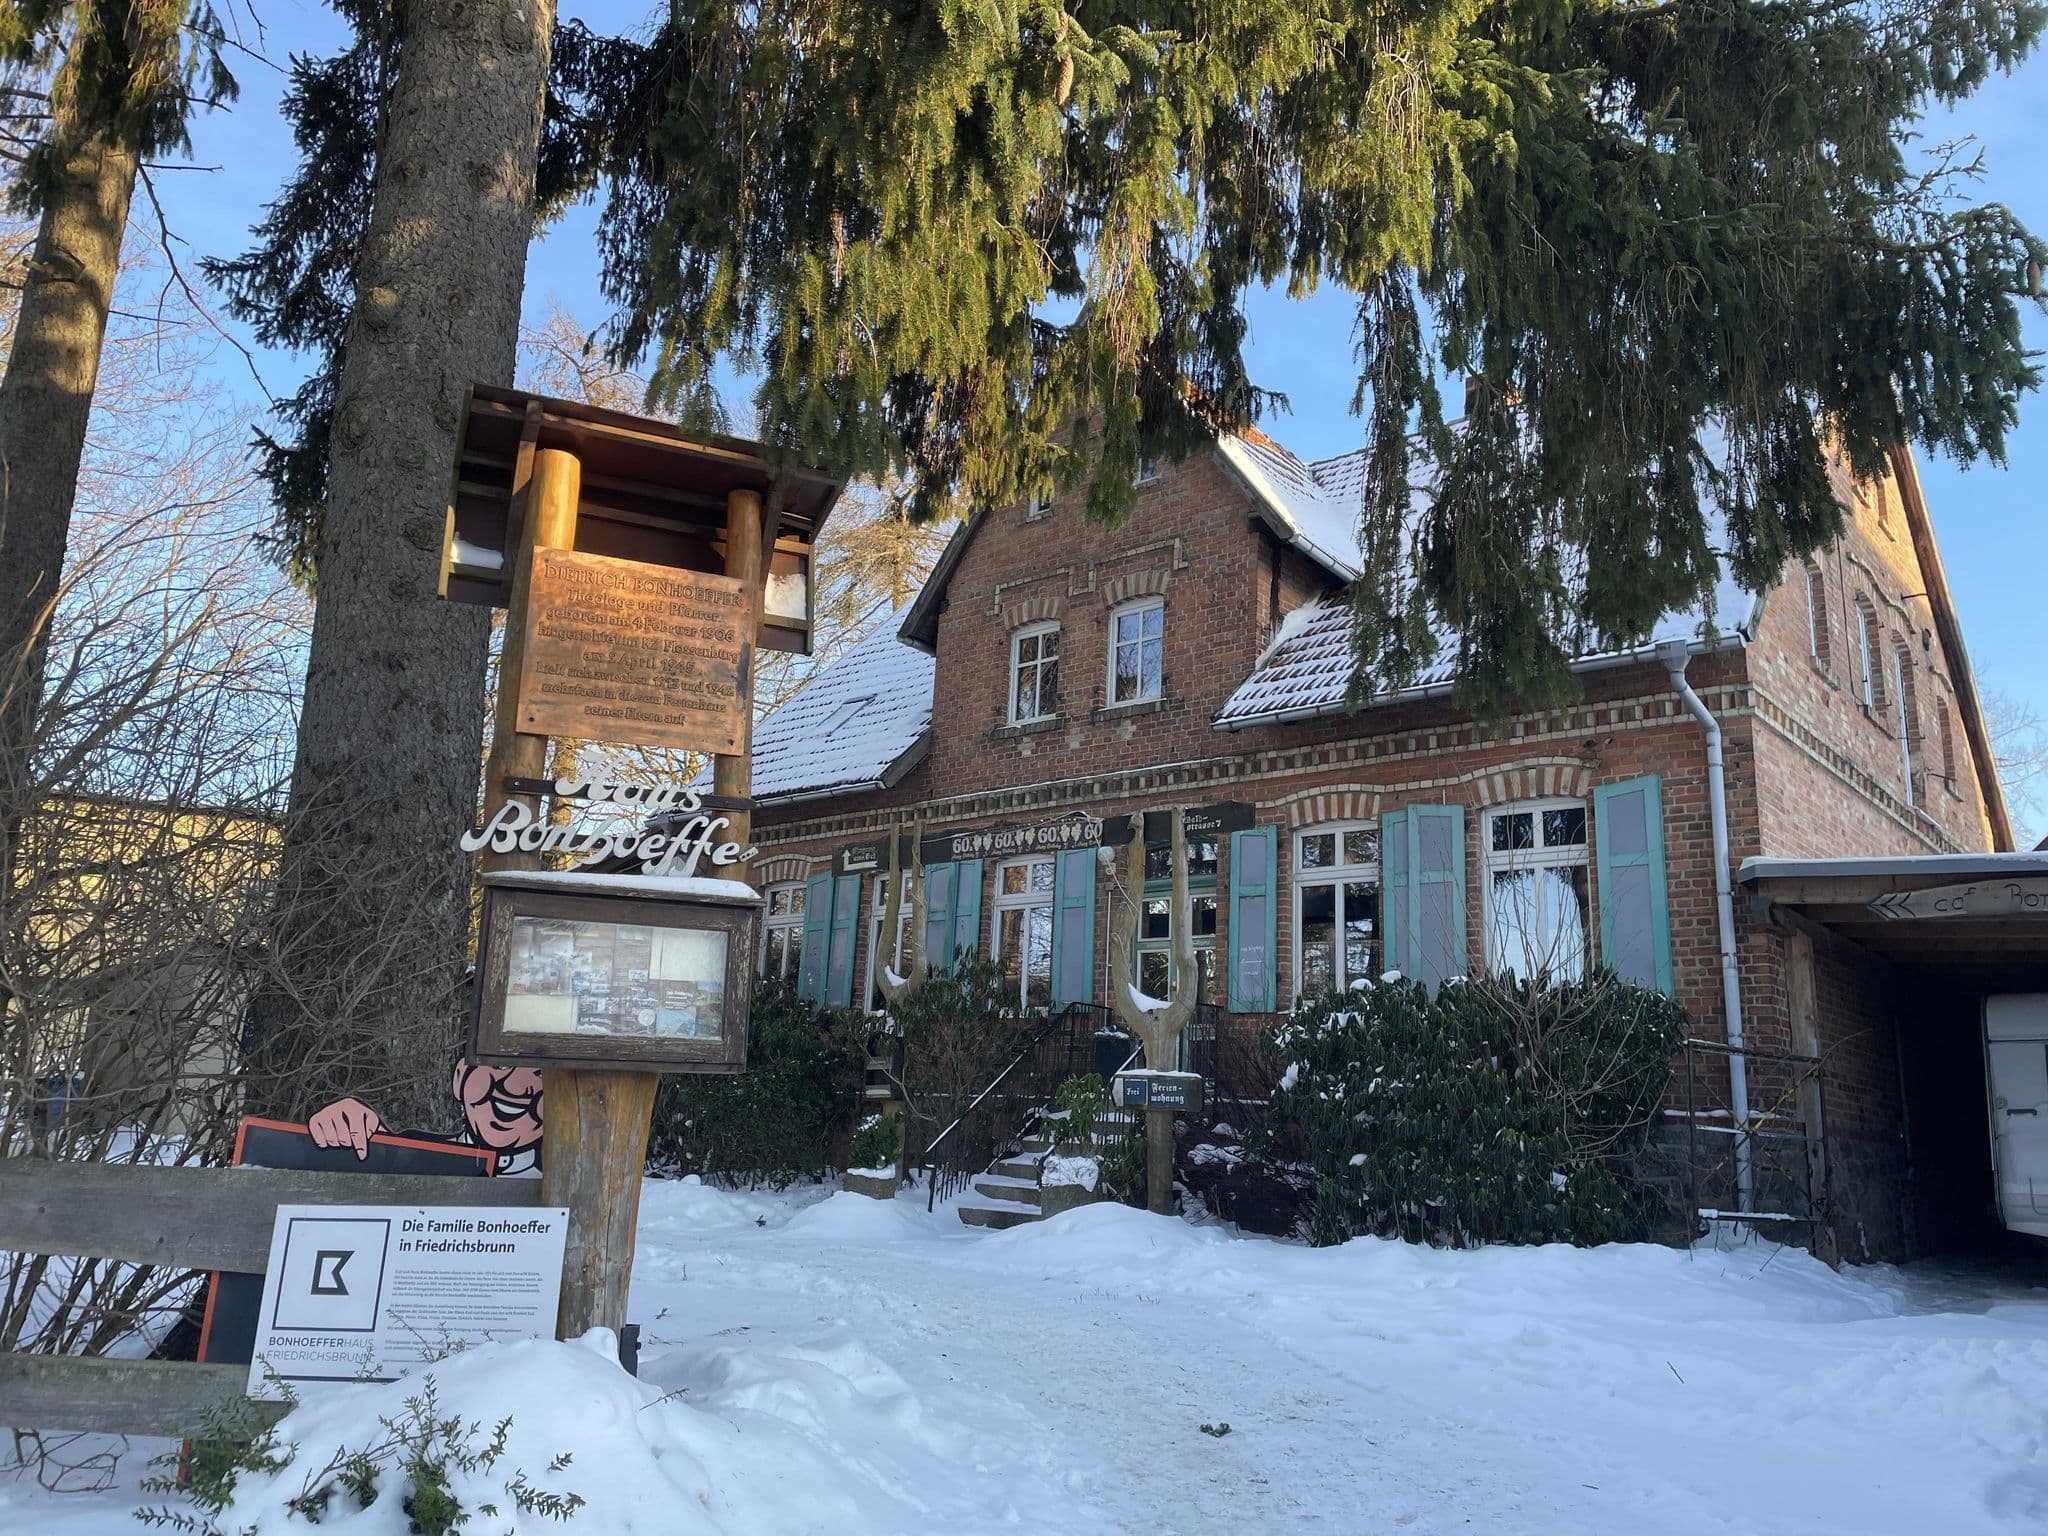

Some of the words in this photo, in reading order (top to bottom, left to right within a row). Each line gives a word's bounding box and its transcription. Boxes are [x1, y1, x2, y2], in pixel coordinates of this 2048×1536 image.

[545, 564, 627, 590] DIETRICH
[633, 577, 743, 607] BONHOEFFER
[568, 587, 635, 609] Theologe
[638, 601, 665, 613] und
[546, 606, 606, 624] geboren
[609, 615, 629, 627] am
[644, 617, 697, 637] Februar
[700, 627, 735, 642] 1906
[641, 637, 658, 651] KZ
[617, 653, 656, 670] April
[661, 657, 695, 674] 1945
[681, 681, 704, 693] und
[555, 750, 706, 812] Haus
[1151, 1094, 1185, 1104] wohnung
[402, 1219, 424, 1232] Die
[427, 1219, 474, 1233] Familie
[477, 1220, 551, 1234] Bonhoeffer
[399, 1239, 412, 1252] in
[415, 1239, 516, 1253] Friedrichsbrunn
[266, 1350, 374, 1363] FRIEDRICHSBRUNN
